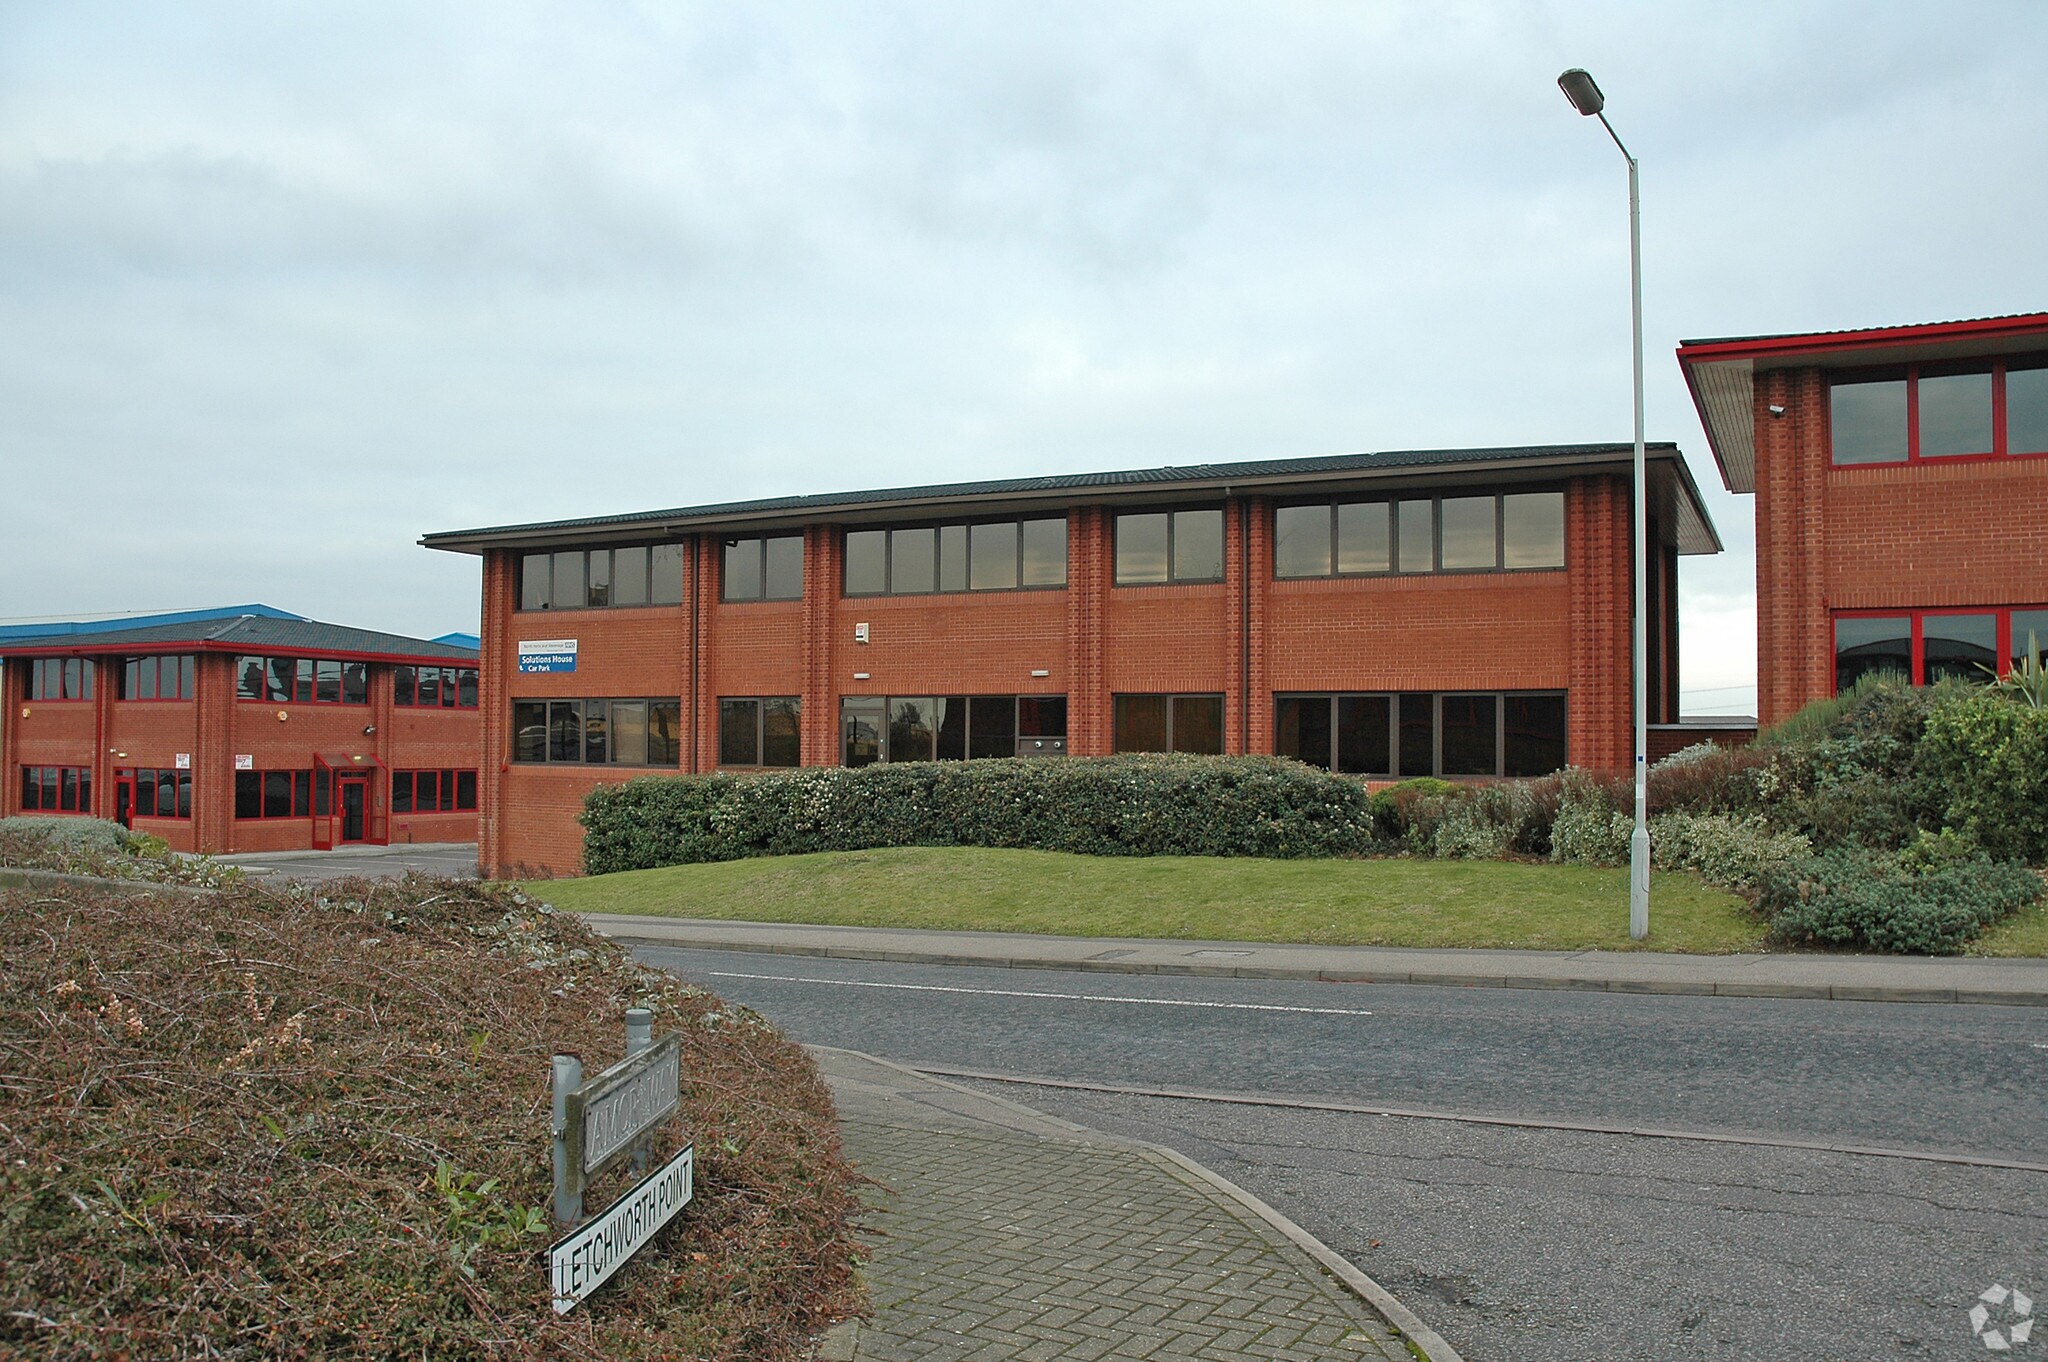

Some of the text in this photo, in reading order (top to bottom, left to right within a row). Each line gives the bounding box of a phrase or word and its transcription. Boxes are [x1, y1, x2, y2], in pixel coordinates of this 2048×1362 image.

[522, 655, 573, 664] Solutions House
[561, 1159, 689, 1297] LETCHWORTH POINT
